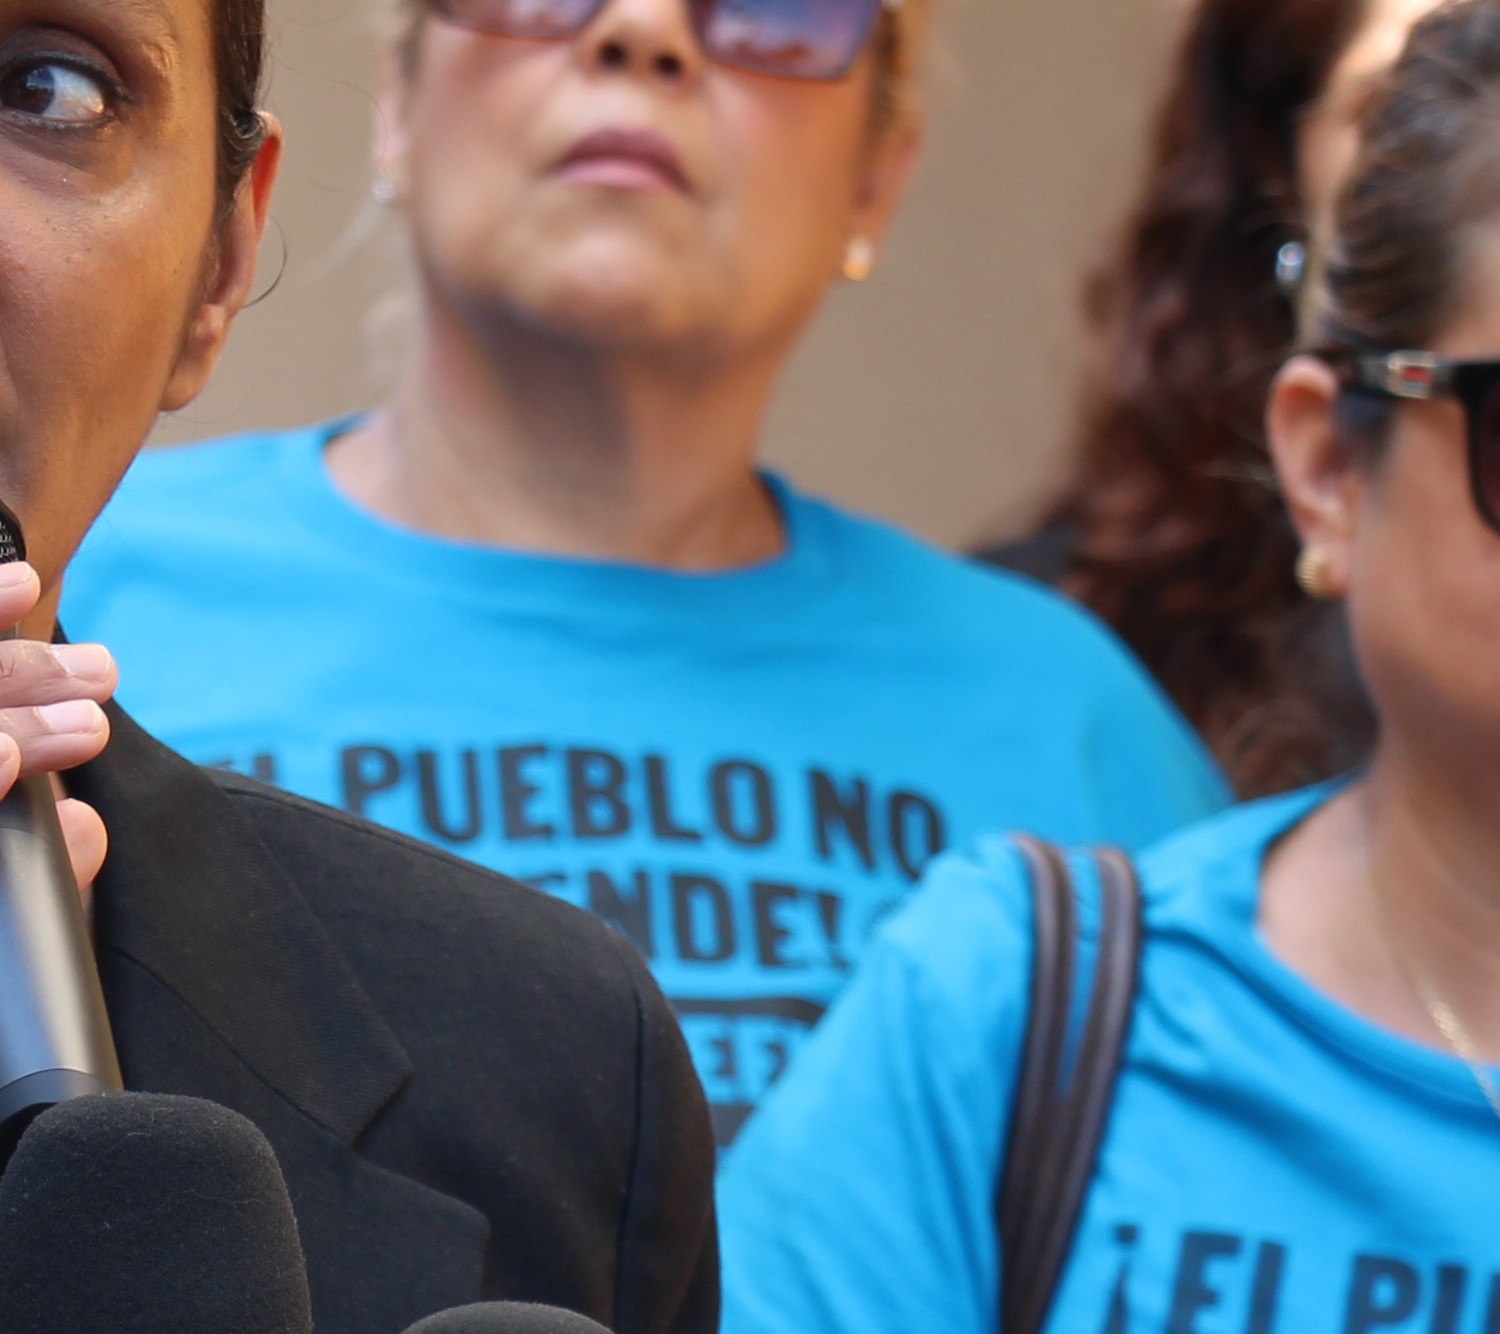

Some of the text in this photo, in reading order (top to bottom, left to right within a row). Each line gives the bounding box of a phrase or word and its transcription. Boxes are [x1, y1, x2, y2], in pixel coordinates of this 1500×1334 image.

[339, 742, 945, 881] PUEBLO NO
[515, 869, 855, 975] NDE!
